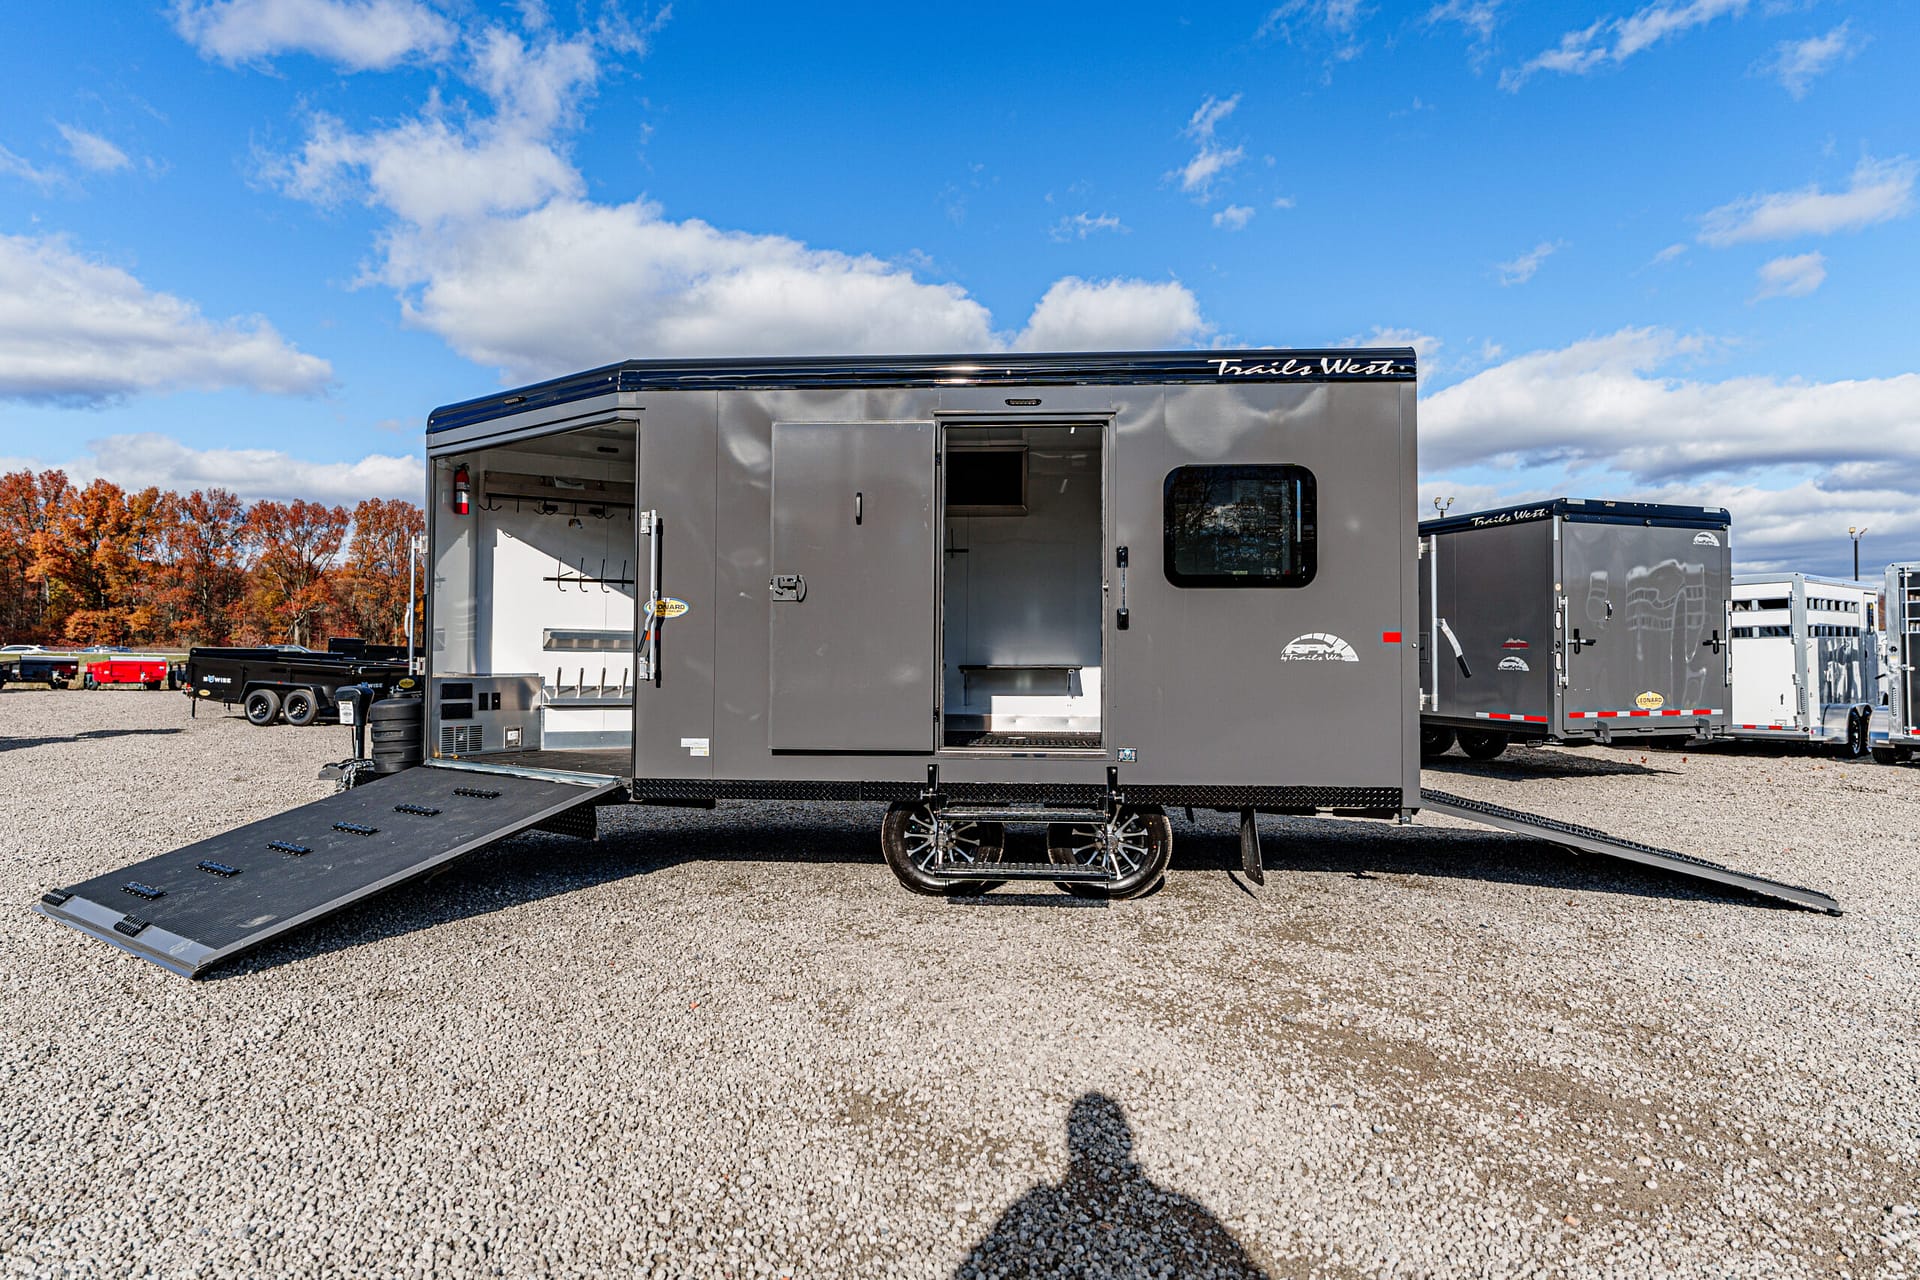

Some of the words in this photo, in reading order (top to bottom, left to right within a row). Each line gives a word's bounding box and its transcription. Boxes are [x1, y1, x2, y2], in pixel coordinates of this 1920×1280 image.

[1207, 358, 1313, 376] Trails
[1320, 357, 1395, 375] West
[1471, 513, 1511, 526] Trails
